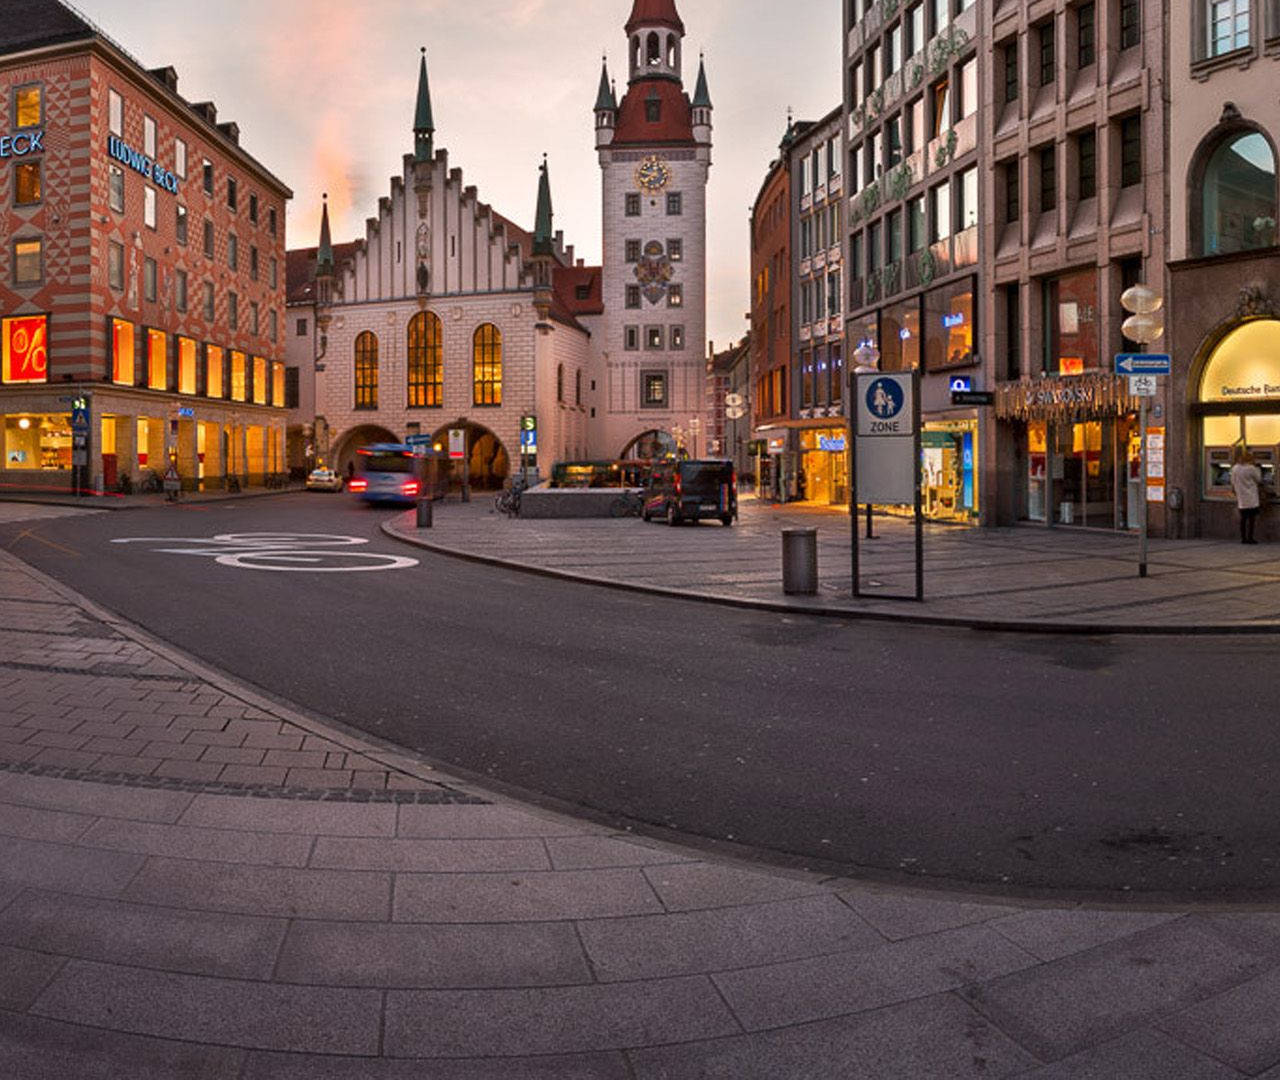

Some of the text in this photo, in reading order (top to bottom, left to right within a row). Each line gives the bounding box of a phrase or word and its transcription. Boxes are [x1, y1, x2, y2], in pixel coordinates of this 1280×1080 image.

[108, 136, 153, 178] LUDWIG
[1221, 385, 1261, 395] Deutsche
[870, 421, 899, 432] ZONE
